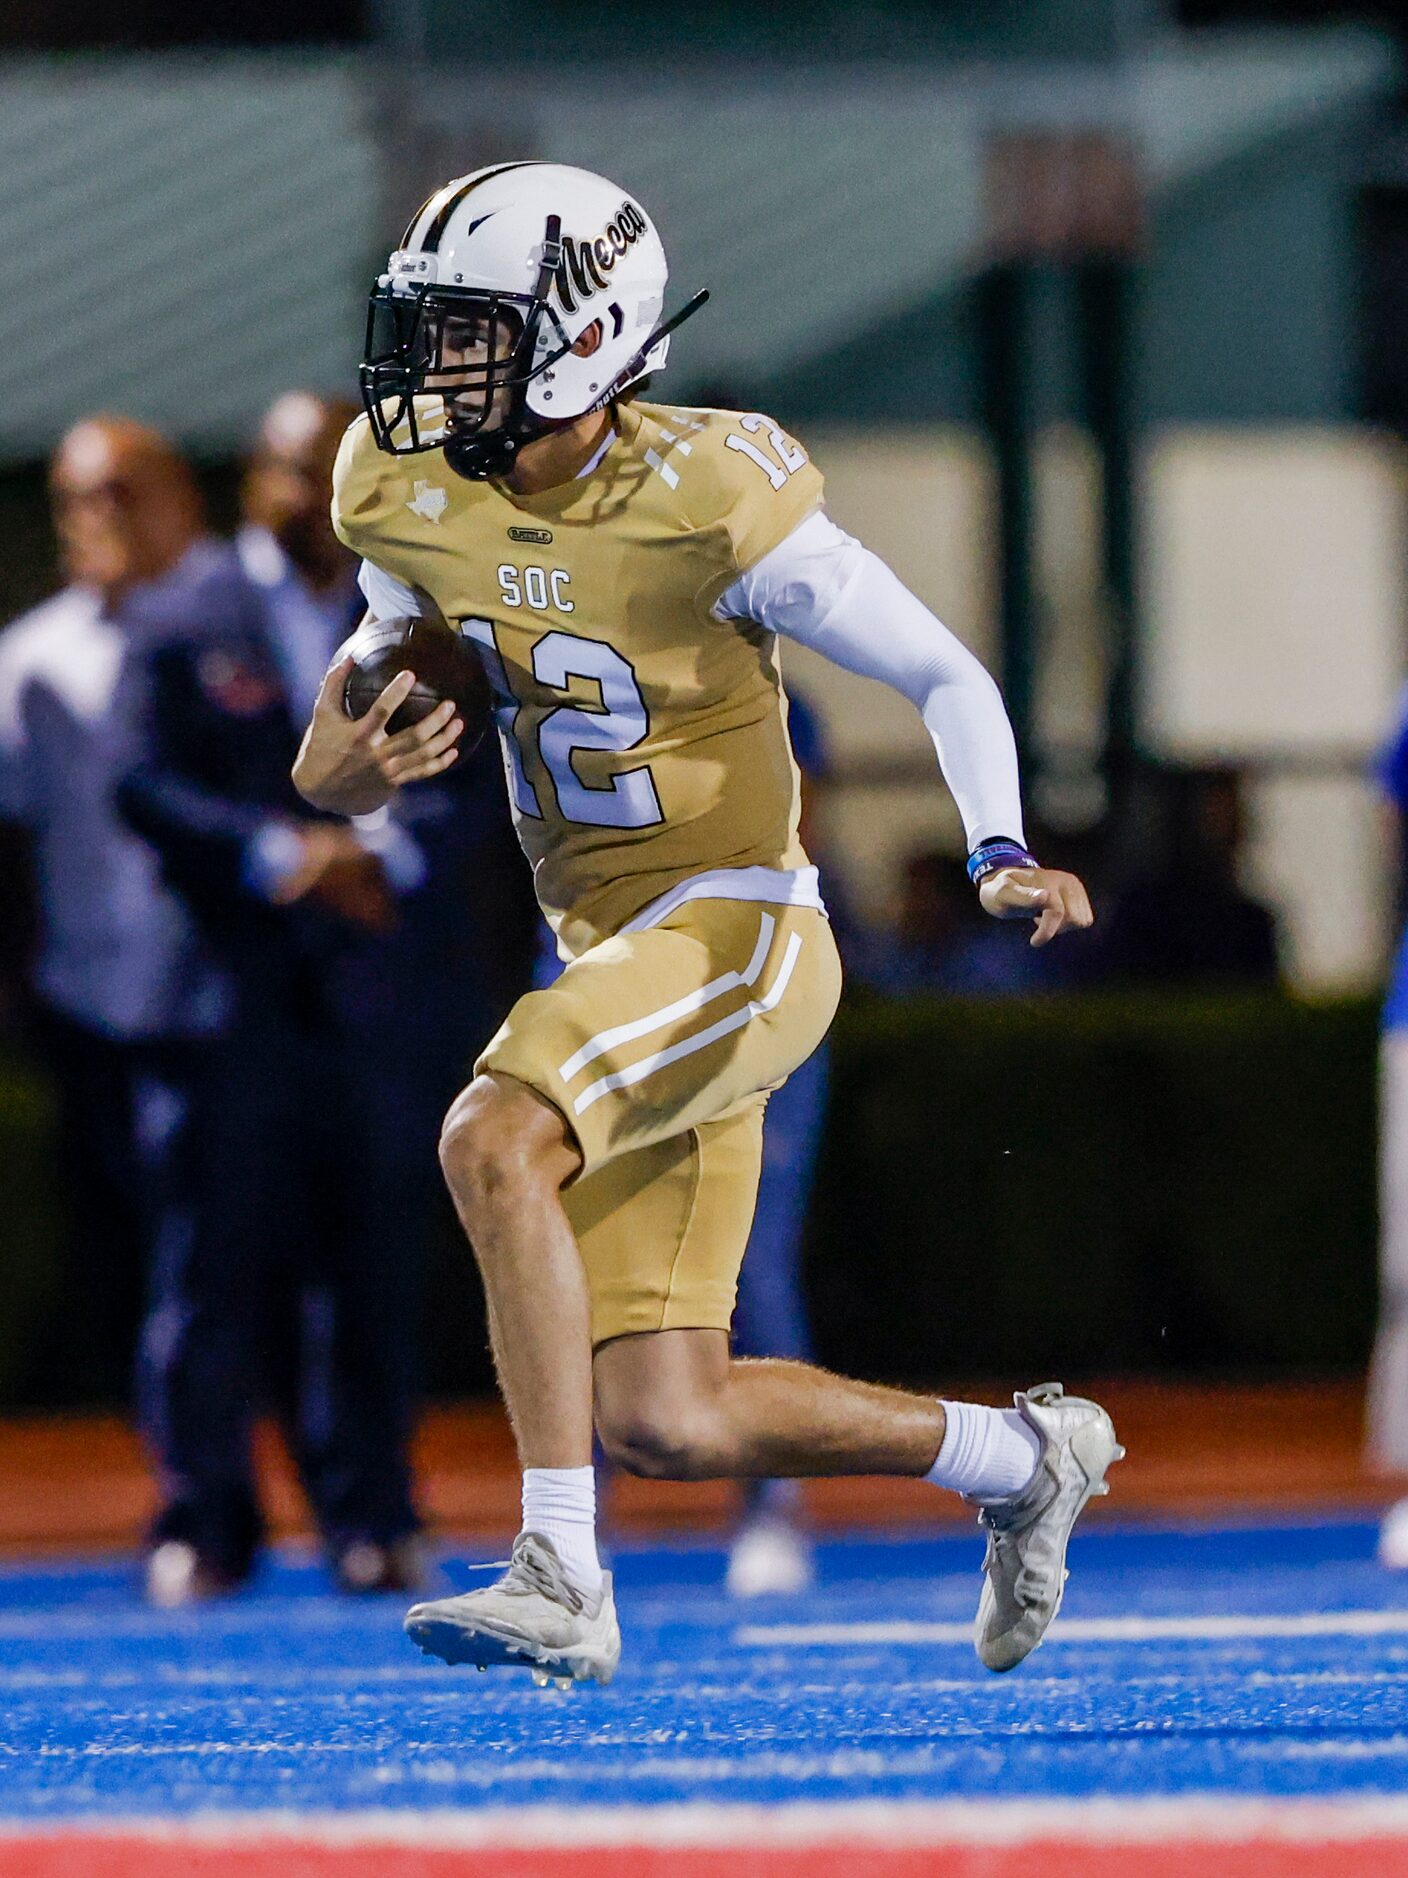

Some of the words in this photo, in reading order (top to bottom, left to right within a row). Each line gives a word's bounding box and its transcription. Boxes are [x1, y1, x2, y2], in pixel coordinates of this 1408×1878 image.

[724, 413, 807, 492] 12
[497, 564, 574, 612] SOC
[459, 617, 665, 830] 12
